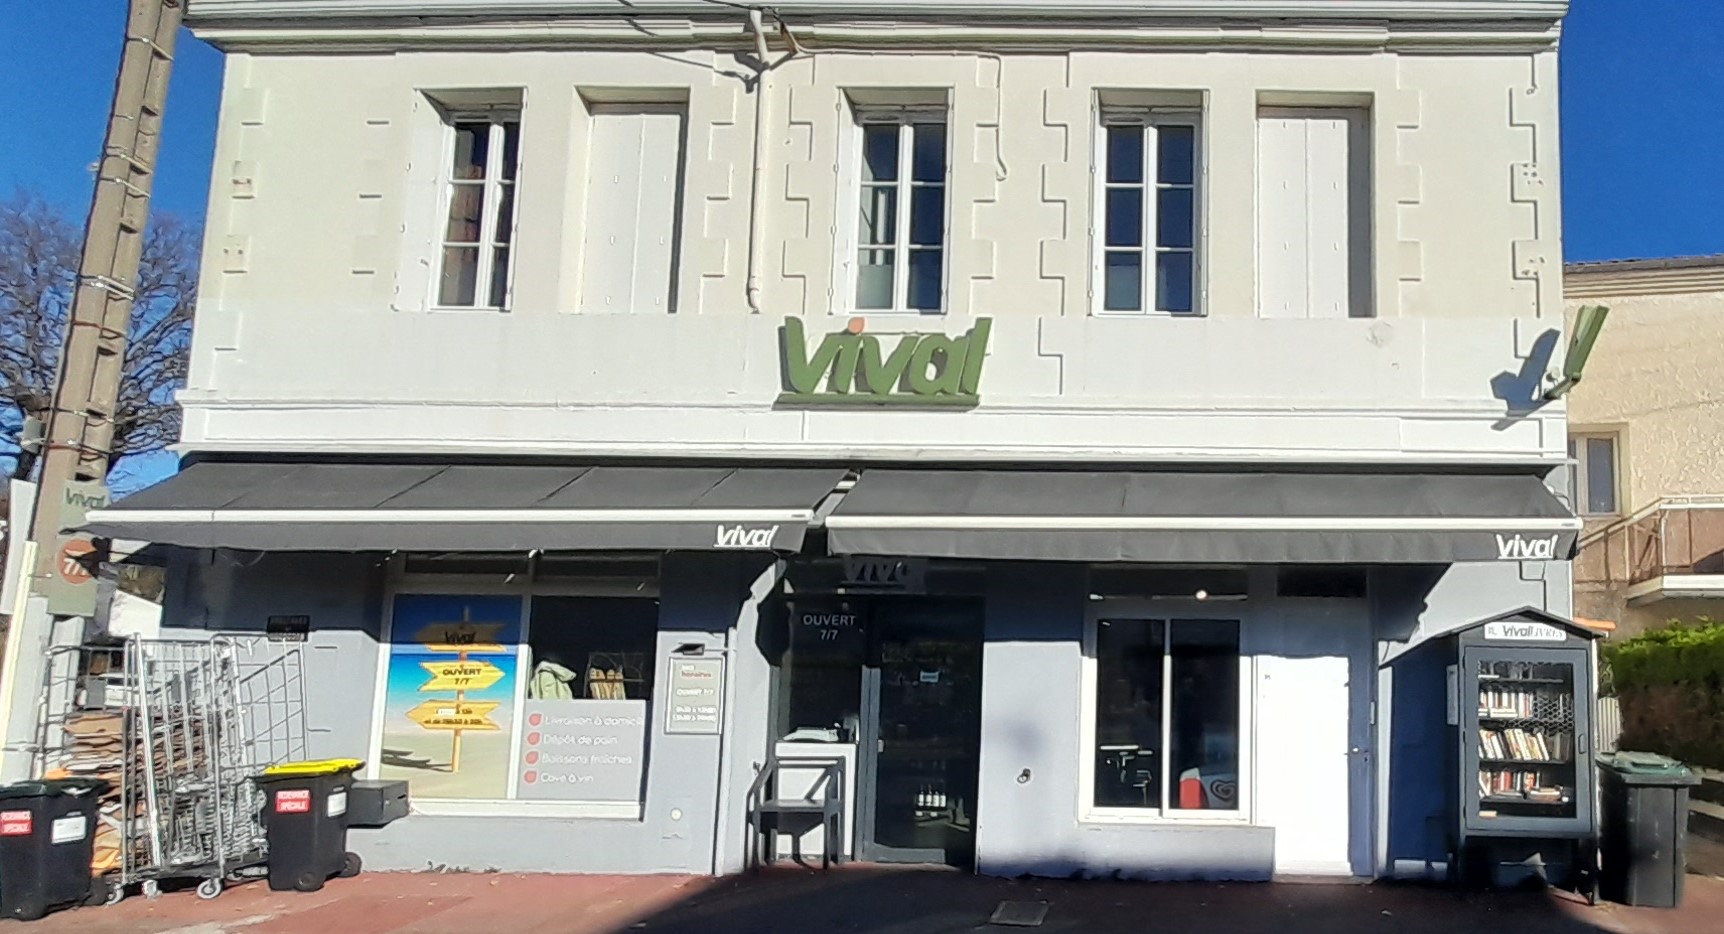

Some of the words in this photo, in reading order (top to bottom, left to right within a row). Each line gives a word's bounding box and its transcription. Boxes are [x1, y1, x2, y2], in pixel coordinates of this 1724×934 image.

[803, 614, 856, 626] OUVERT
[820, 629, 839, 641] 7/7
[442, 668, 481, 676] OUVERT
[578, 735, 591, 745] de
[593, 737, 618, 746] pain
[540, 773, 566, 783] Cave
[578, 774, 594, 784] vin
